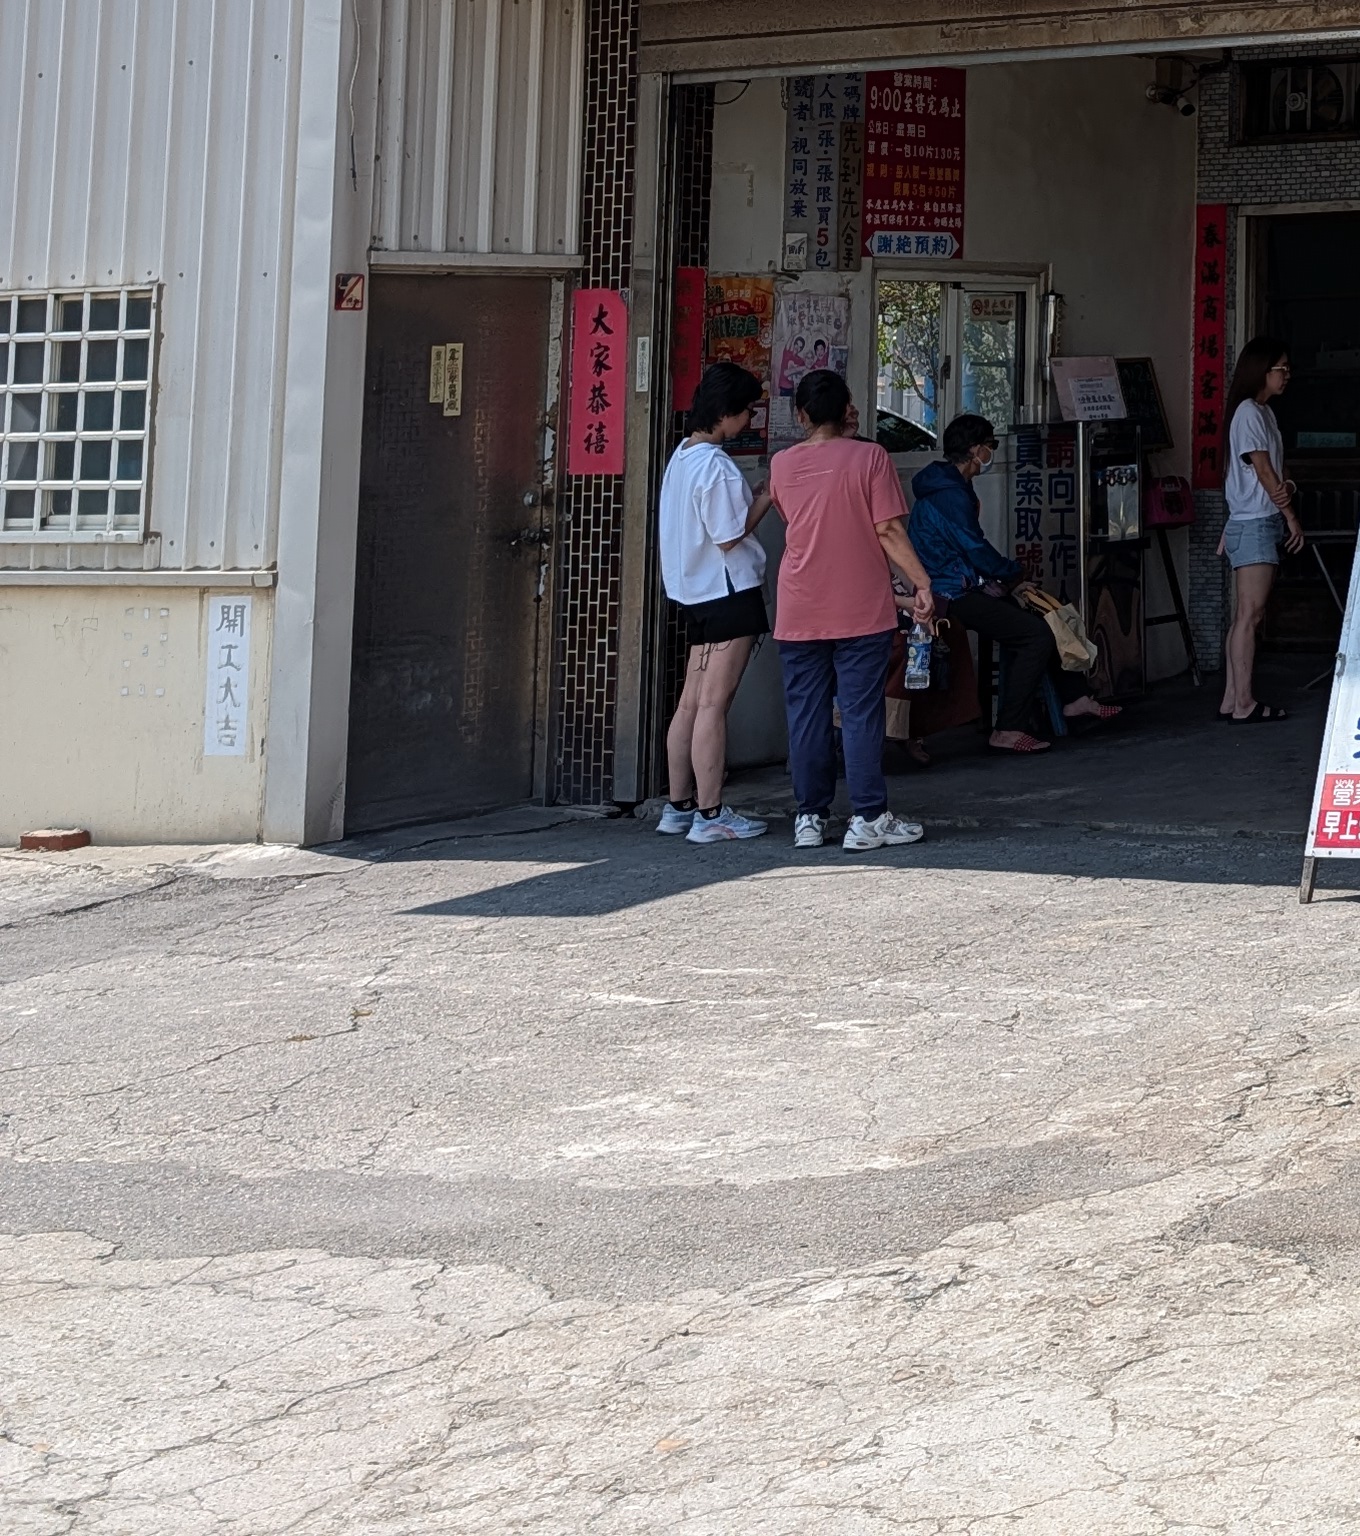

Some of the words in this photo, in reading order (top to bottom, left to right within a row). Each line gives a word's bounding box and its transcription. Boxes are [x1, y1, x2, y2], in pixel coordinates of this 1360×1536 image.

[582, 303, 615, 455] 大家恭禧
[1014, 431, 1044, 586] 員索取號
[215, 603, 247, 748] 開工大吉
